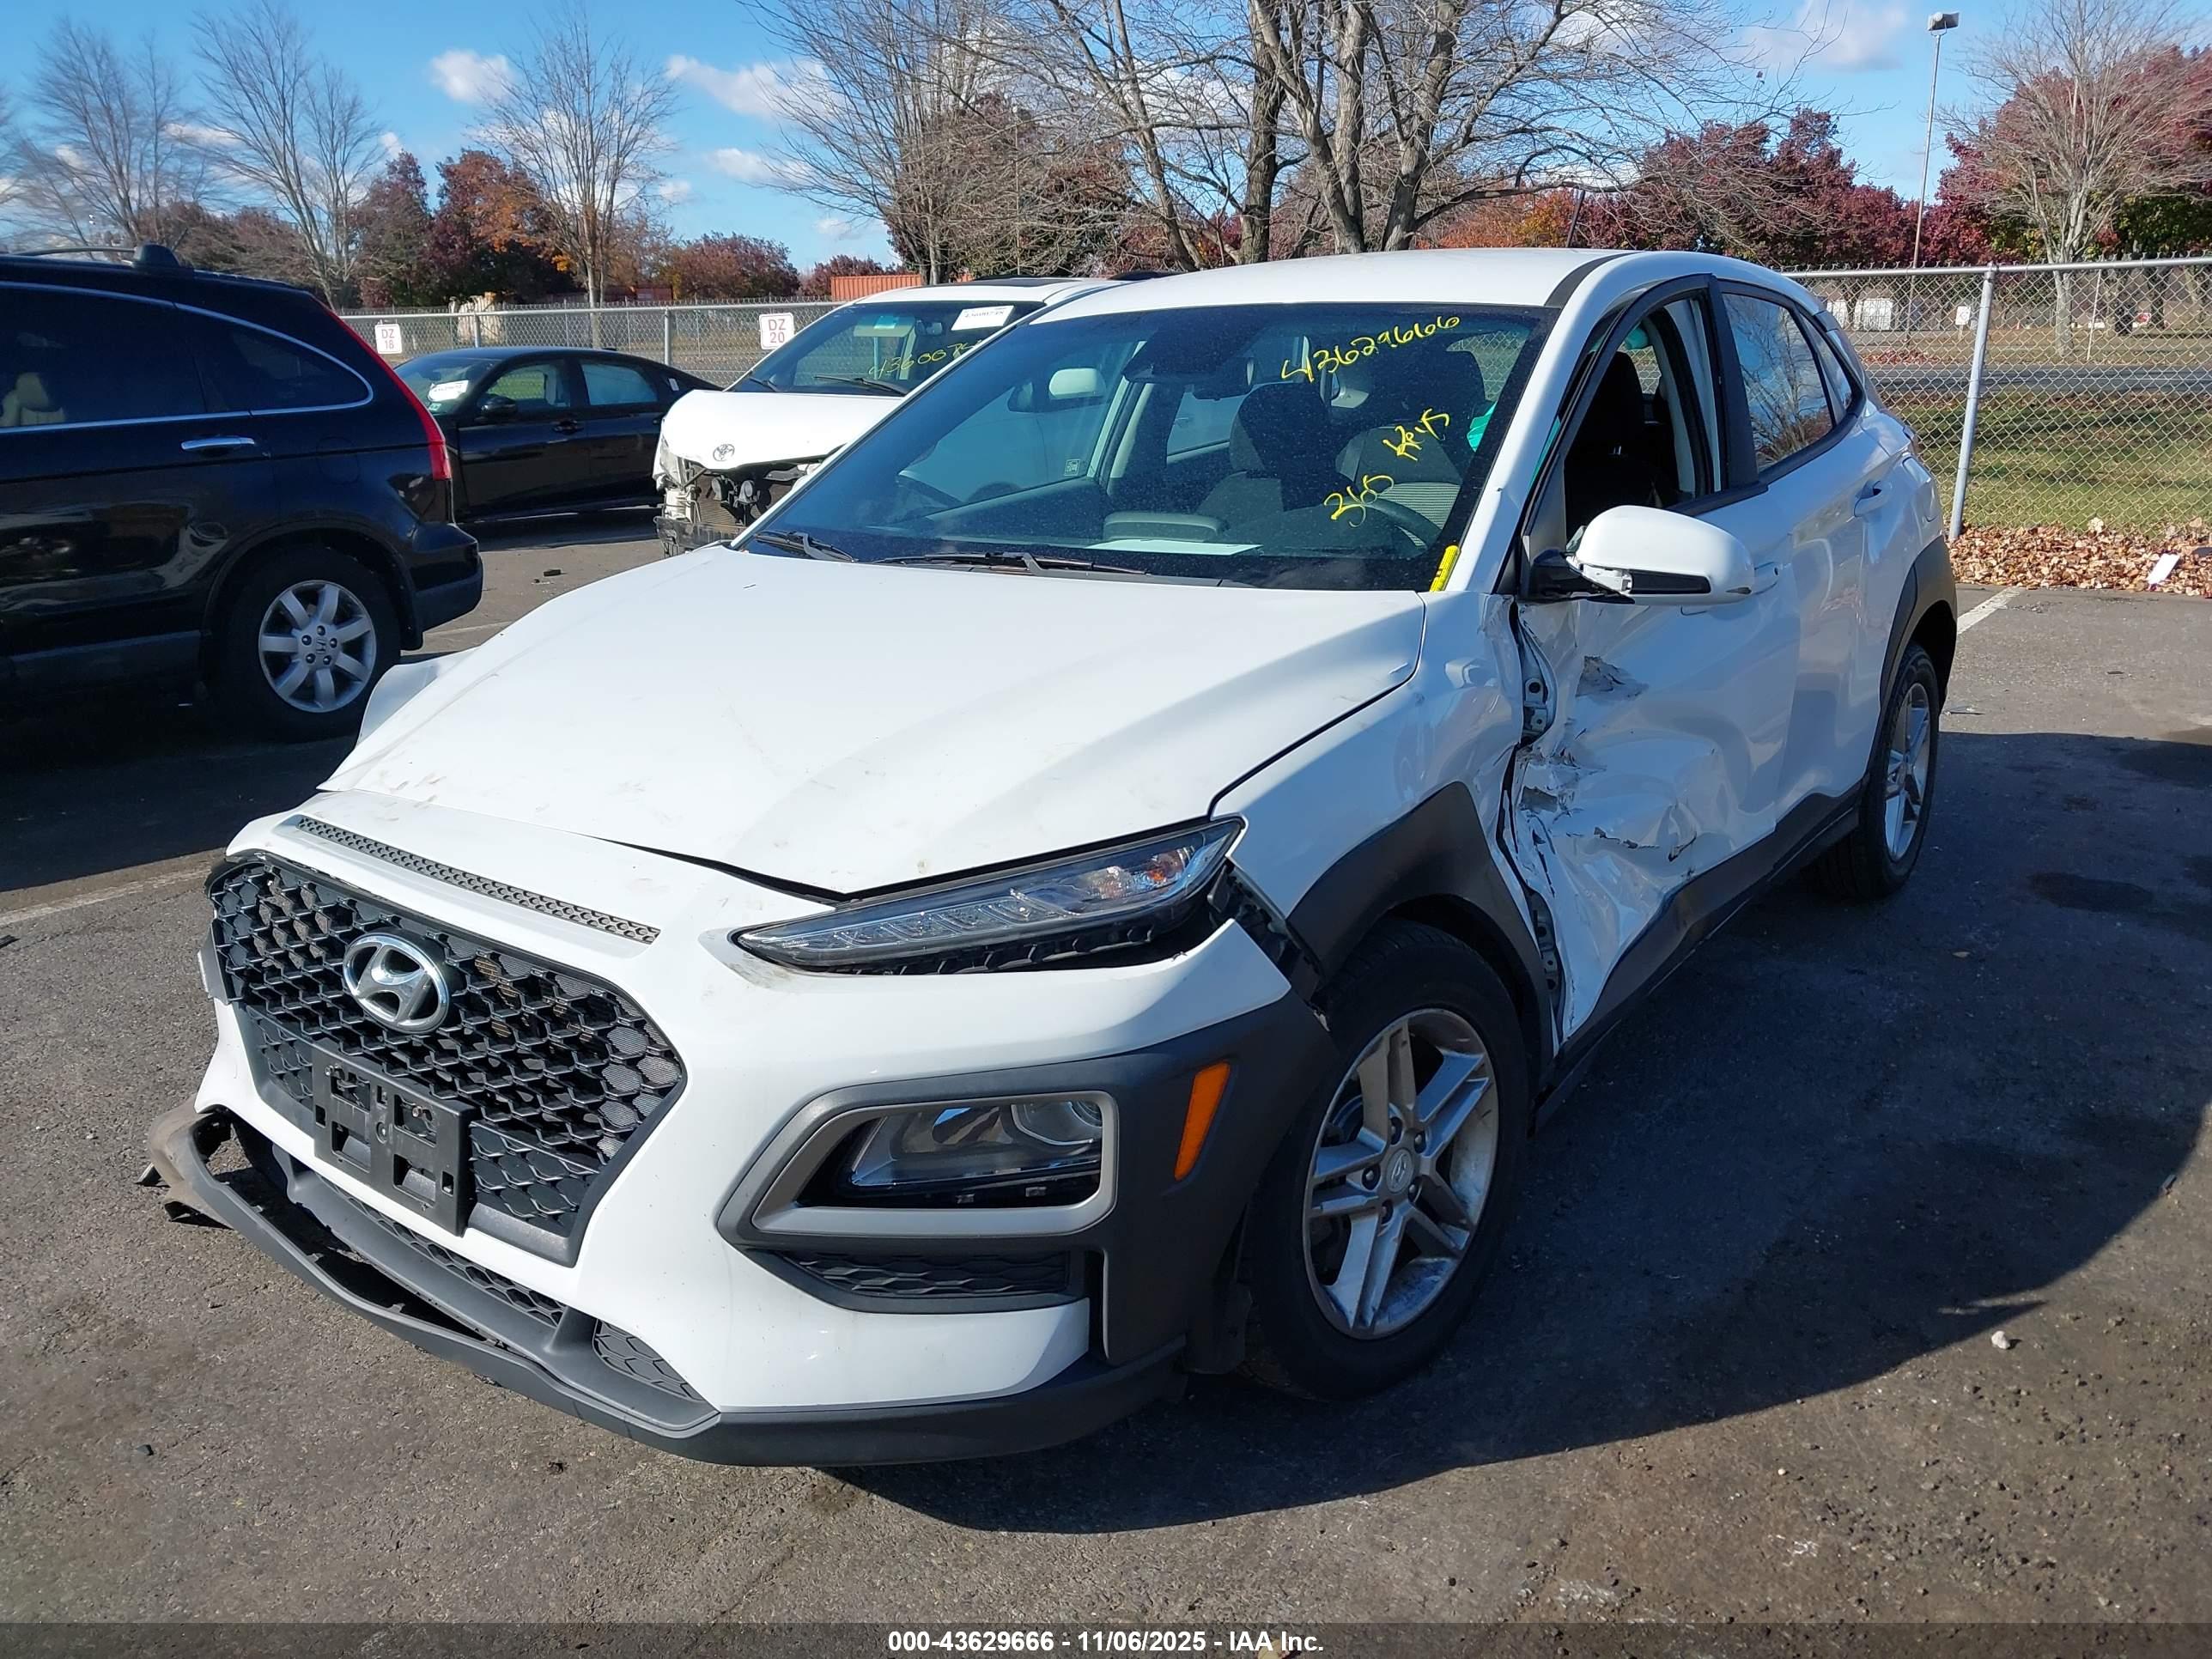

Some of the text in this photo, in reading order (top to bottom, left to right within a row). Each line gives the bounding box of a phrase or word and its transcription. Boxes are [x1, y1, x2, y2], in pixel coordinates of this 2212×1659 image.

[768, 319, 787, 331] DZ
[381, 328, 395, 339] DZ
[769, 331, 785, 343] 20
[384, 339, 395, 350] 18
